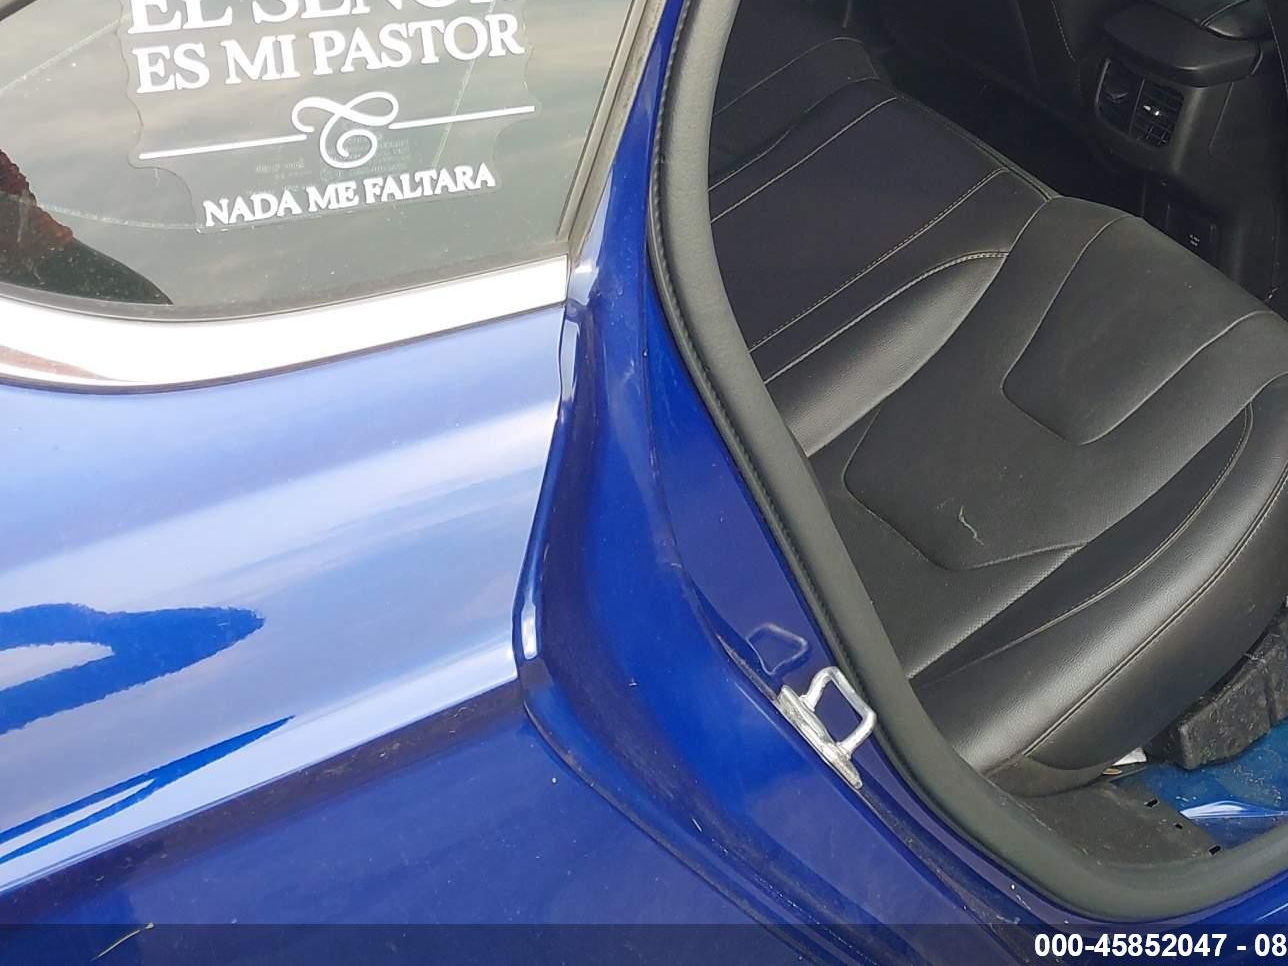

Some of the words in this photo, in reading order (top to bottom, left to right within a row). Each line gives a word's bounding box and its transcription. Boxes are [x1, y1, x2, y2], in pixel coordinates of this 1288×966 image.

[131, 41, 211, 94] ES
[220, 33, 301, 85] MI
[308, 13, 525, 76] PASTOR
[202, 189, 304, 227] NADA
[305, 179, 360, 212] ME
[363, 162, 496, 204] FALTARA
